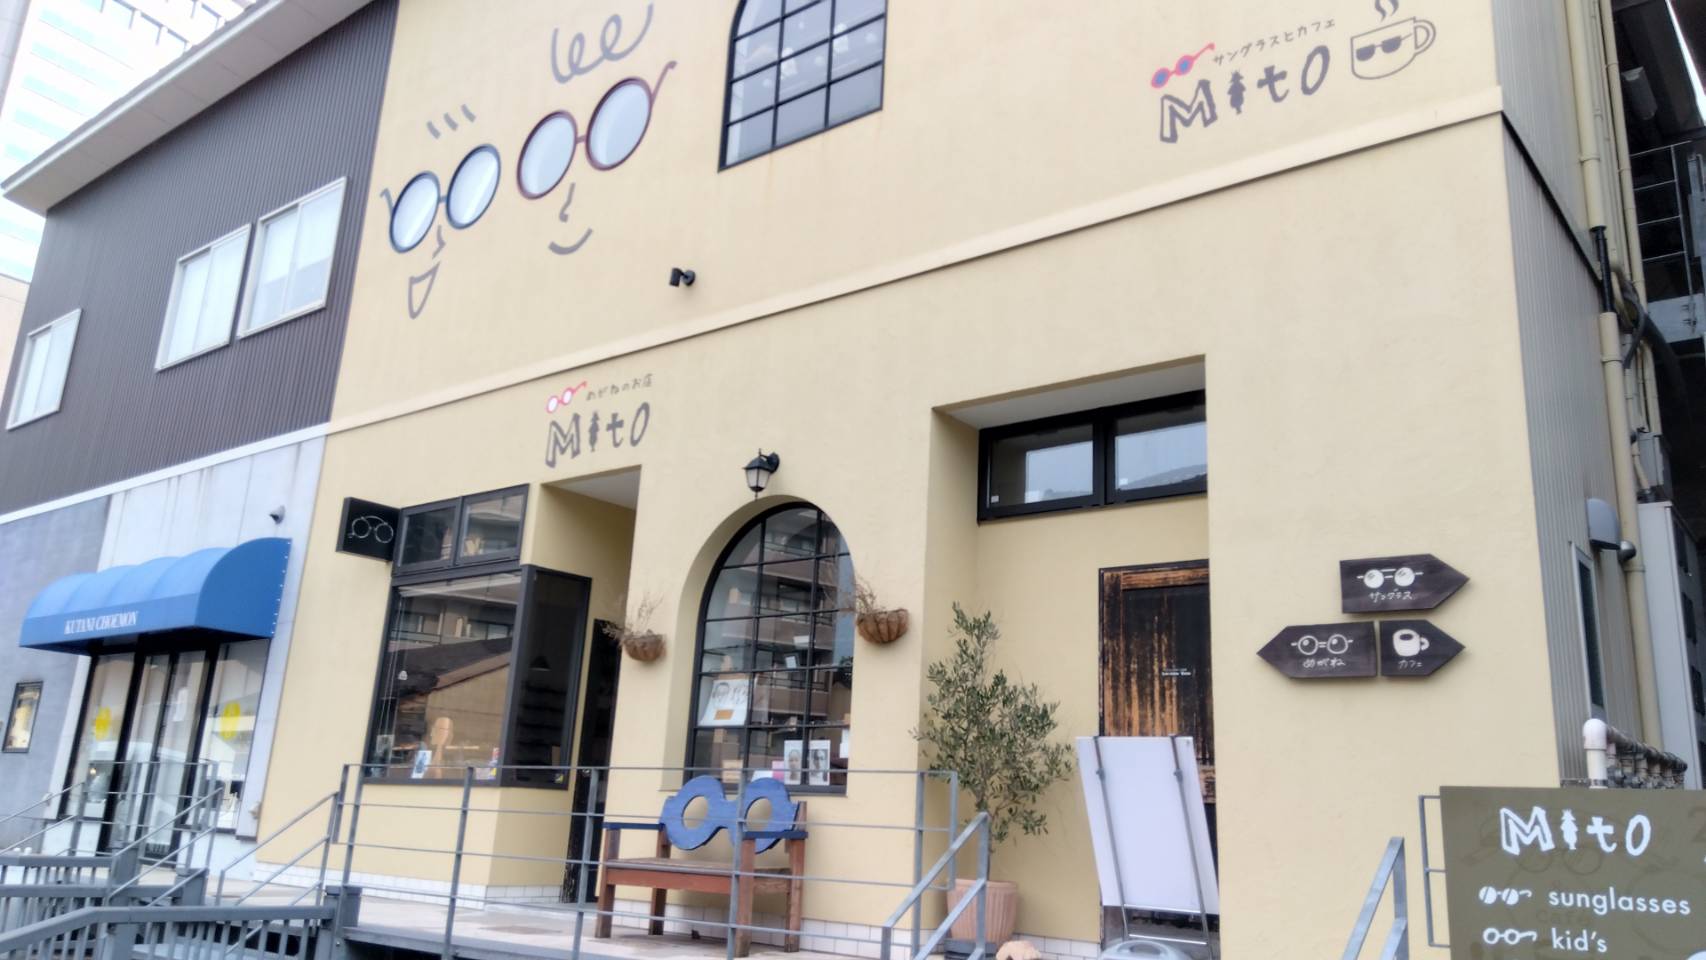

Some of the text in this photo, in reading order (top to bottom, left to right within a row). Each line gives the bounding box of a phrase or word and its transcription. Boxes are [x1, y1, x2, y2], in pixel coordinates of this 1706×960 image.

[1369, 588, 1413, 602] サングラス
[1303, 657, 1346, 668] めがね
[1398, 659, 1424, 670] カフェ
[1549, 887, 1691, 915] sunglasses
[1551, 926, 1608, 953] kid's
